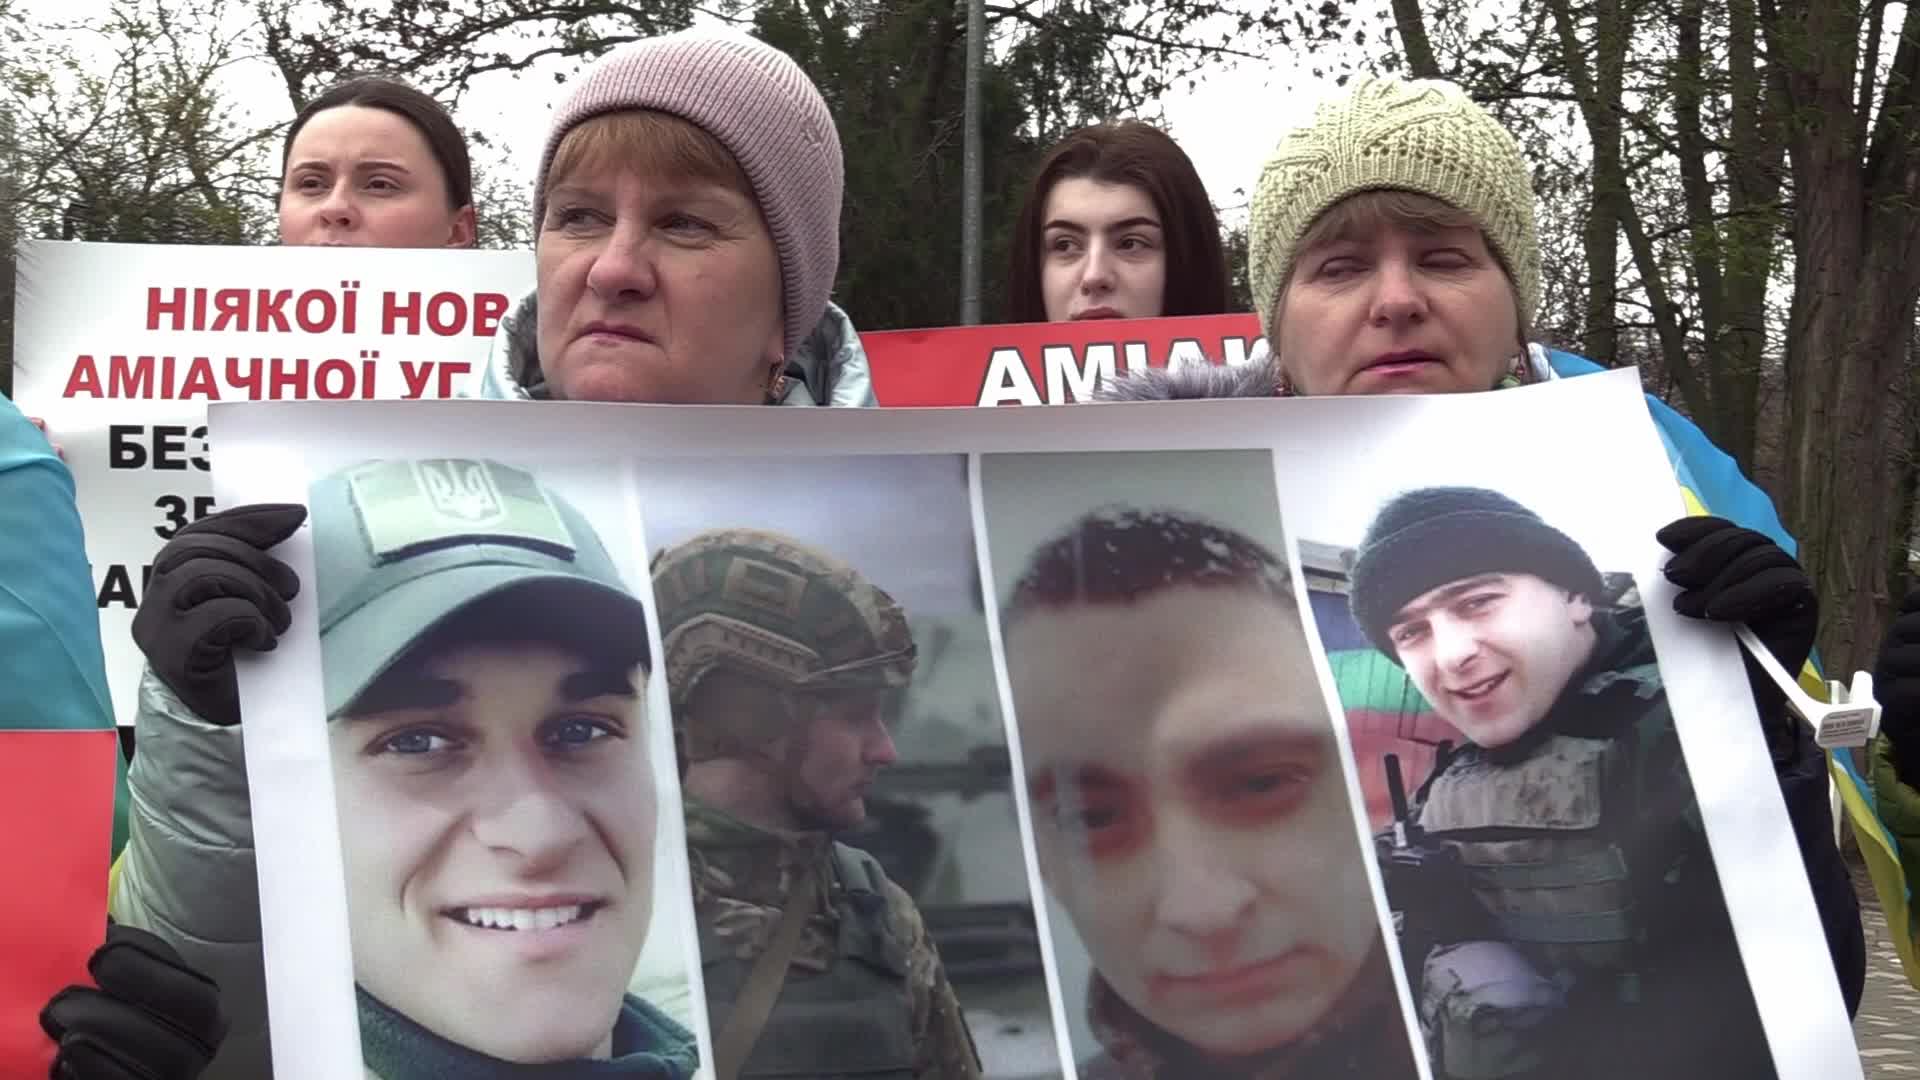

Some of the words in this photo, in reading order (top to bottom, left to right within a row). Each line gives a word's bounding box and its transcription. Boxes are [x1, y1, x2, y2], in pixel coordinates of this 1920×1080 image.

[146, 281, 361, 333] НІЯКОЇ
[381, 291, 509, 337] НОВ
[63, 350, 380, 400] АМІАЧНОЇ
